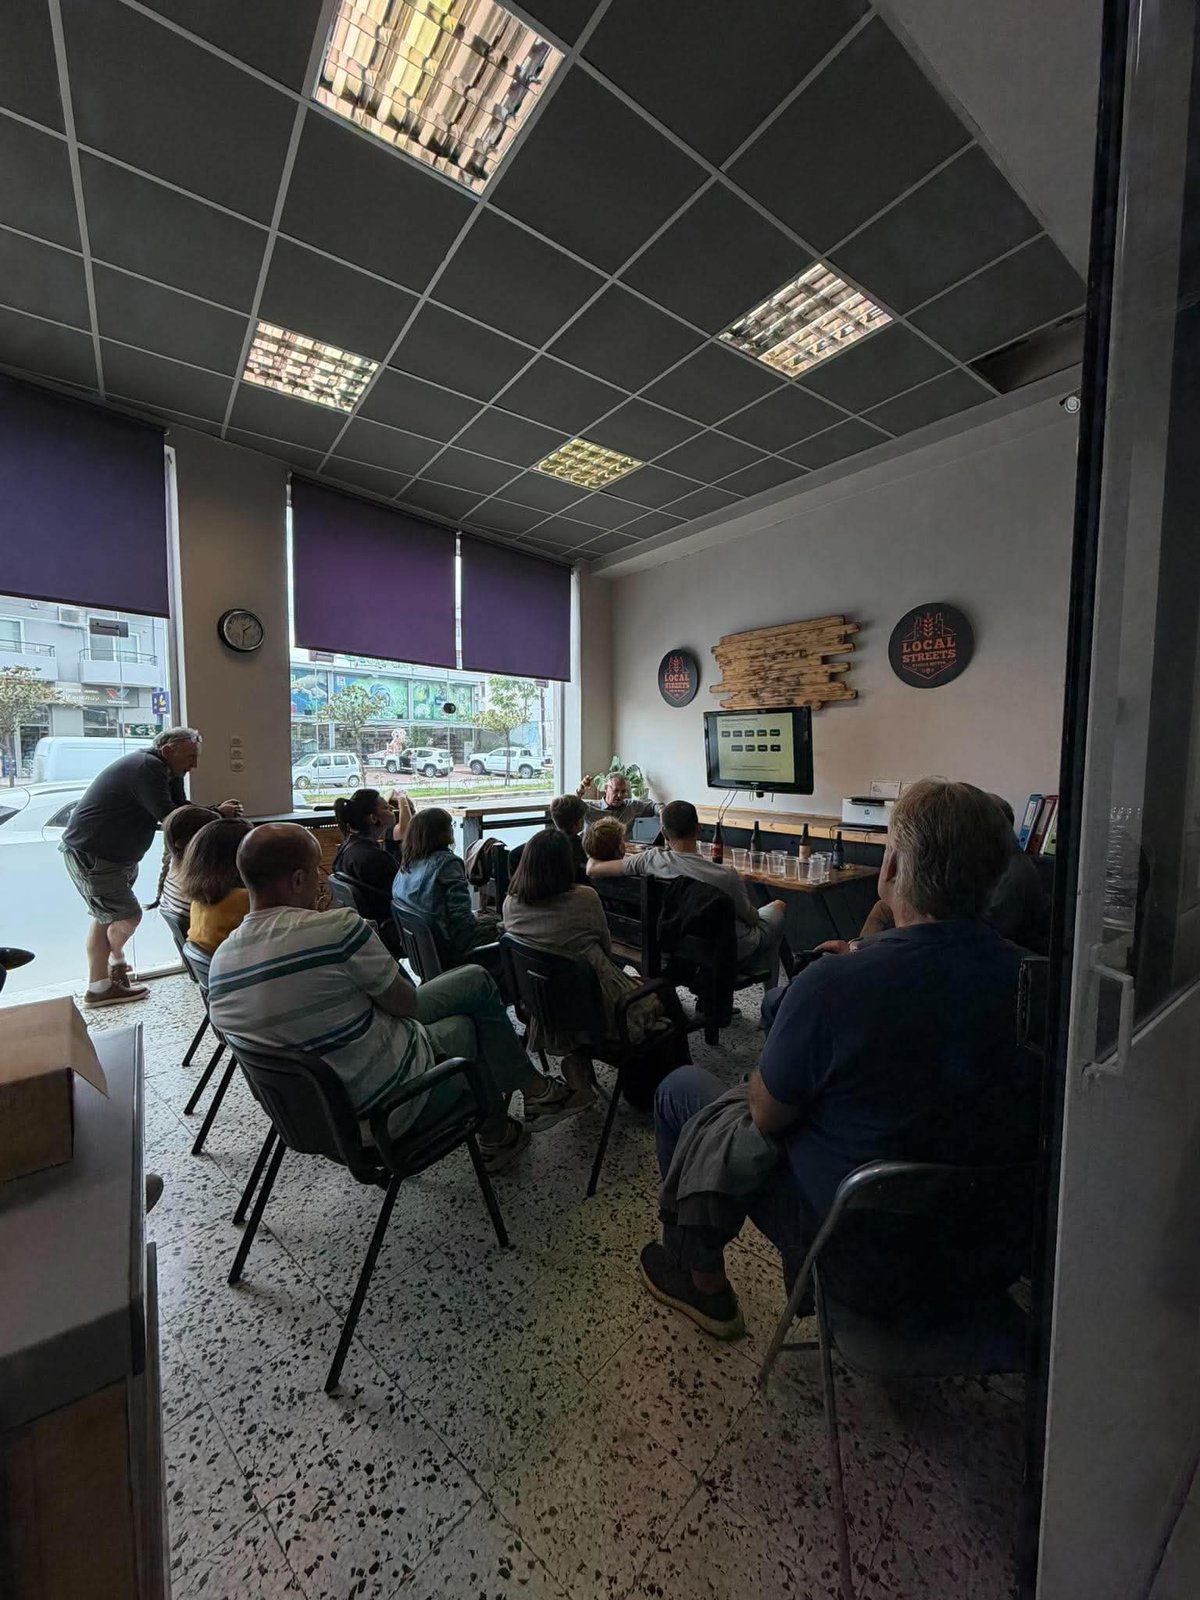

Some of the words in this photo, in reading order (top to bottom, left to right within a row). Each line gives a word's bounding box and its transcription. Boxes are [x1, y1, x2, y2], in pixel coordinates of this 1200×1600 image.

[902, 637, 956, 653] LOCAL
[902, 649, 956, 663] STREETS
[664, 674, 689, 682] LOCAL
